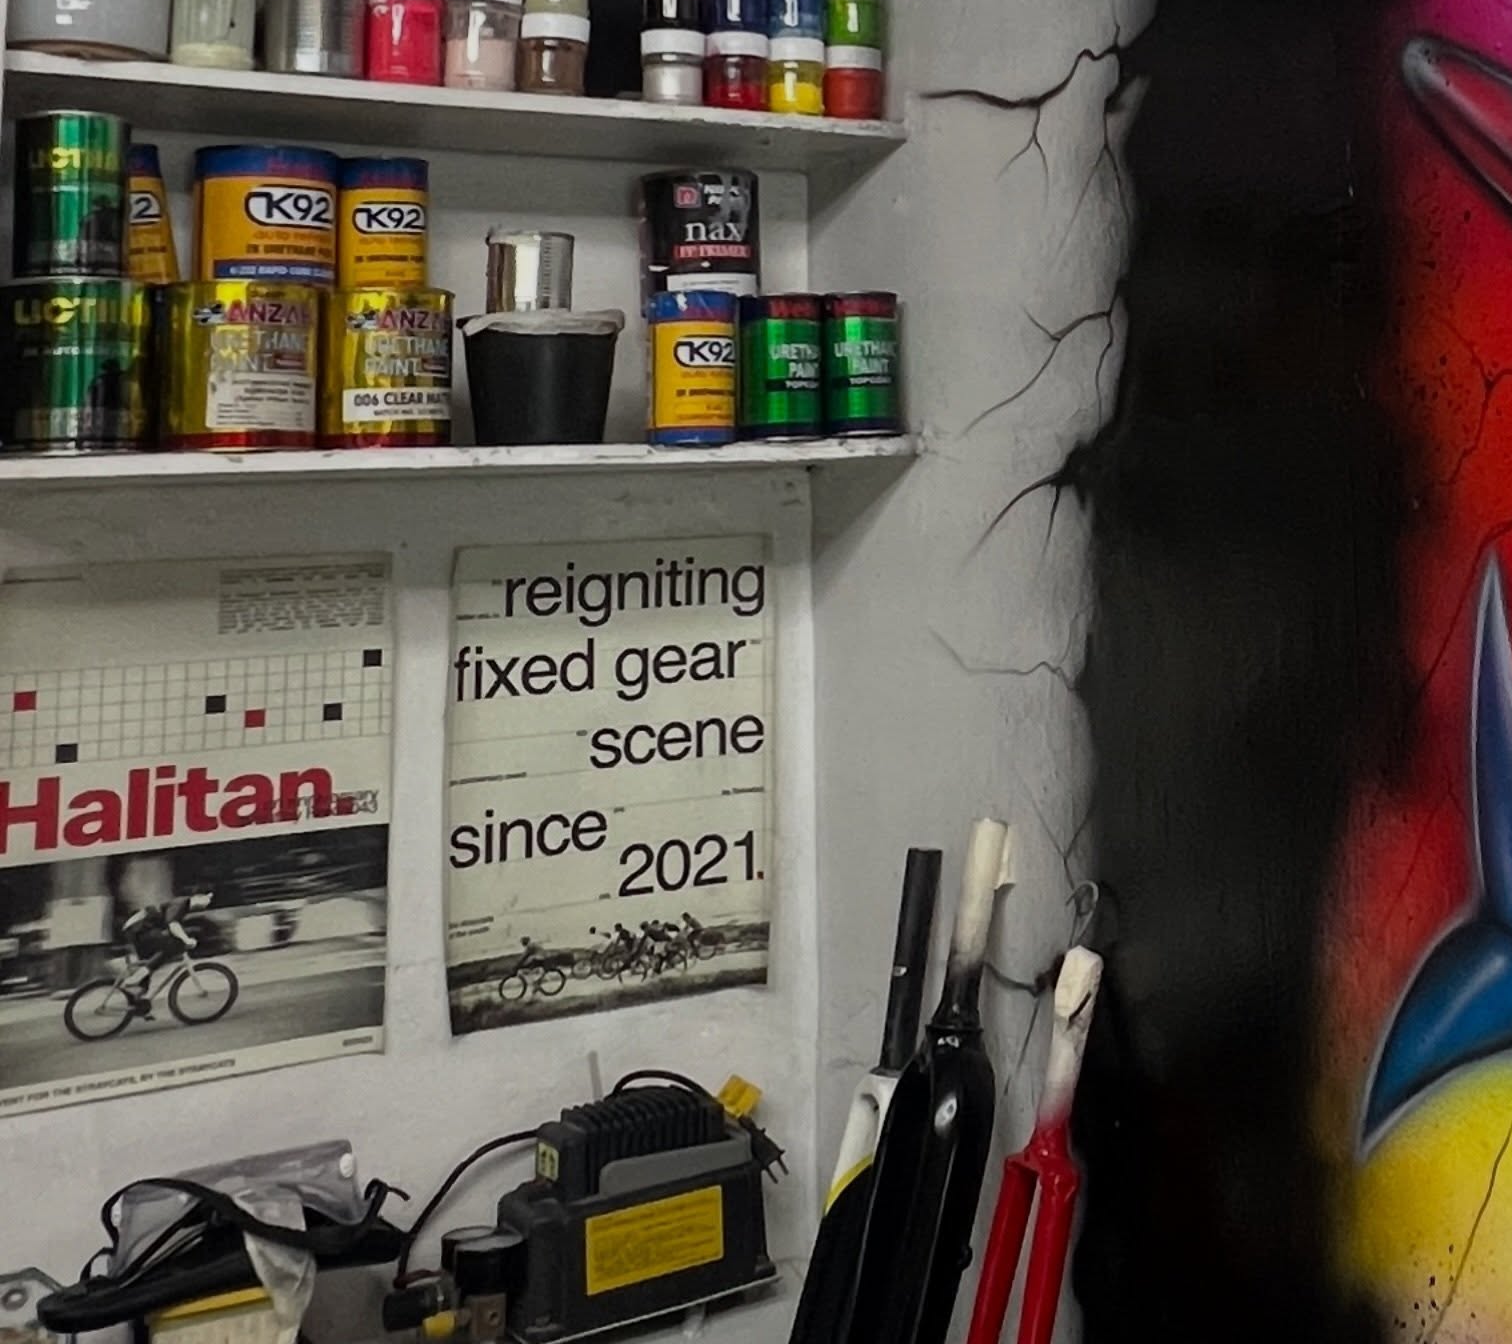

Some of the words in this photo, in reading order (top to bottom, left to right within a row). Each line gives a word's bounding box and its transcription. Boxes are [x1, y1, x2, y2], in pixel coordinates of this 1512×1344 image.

[251, 191, 333, 224] K92
[357, 207, 426, 229] K92
[685, 222, 742, 243] nax
[676, 340, 735, 364] K92
[383, 391, 424, 406] CLEAR
[503, 557, 765, 627] reigniting
[453, 638, 595, 702] fixed
[614, 639, 746, 702] gear
[590, 714, 764, 769] scene
[449, 809, 608, 869] since
[618, 829, 764, 898] 2021.
